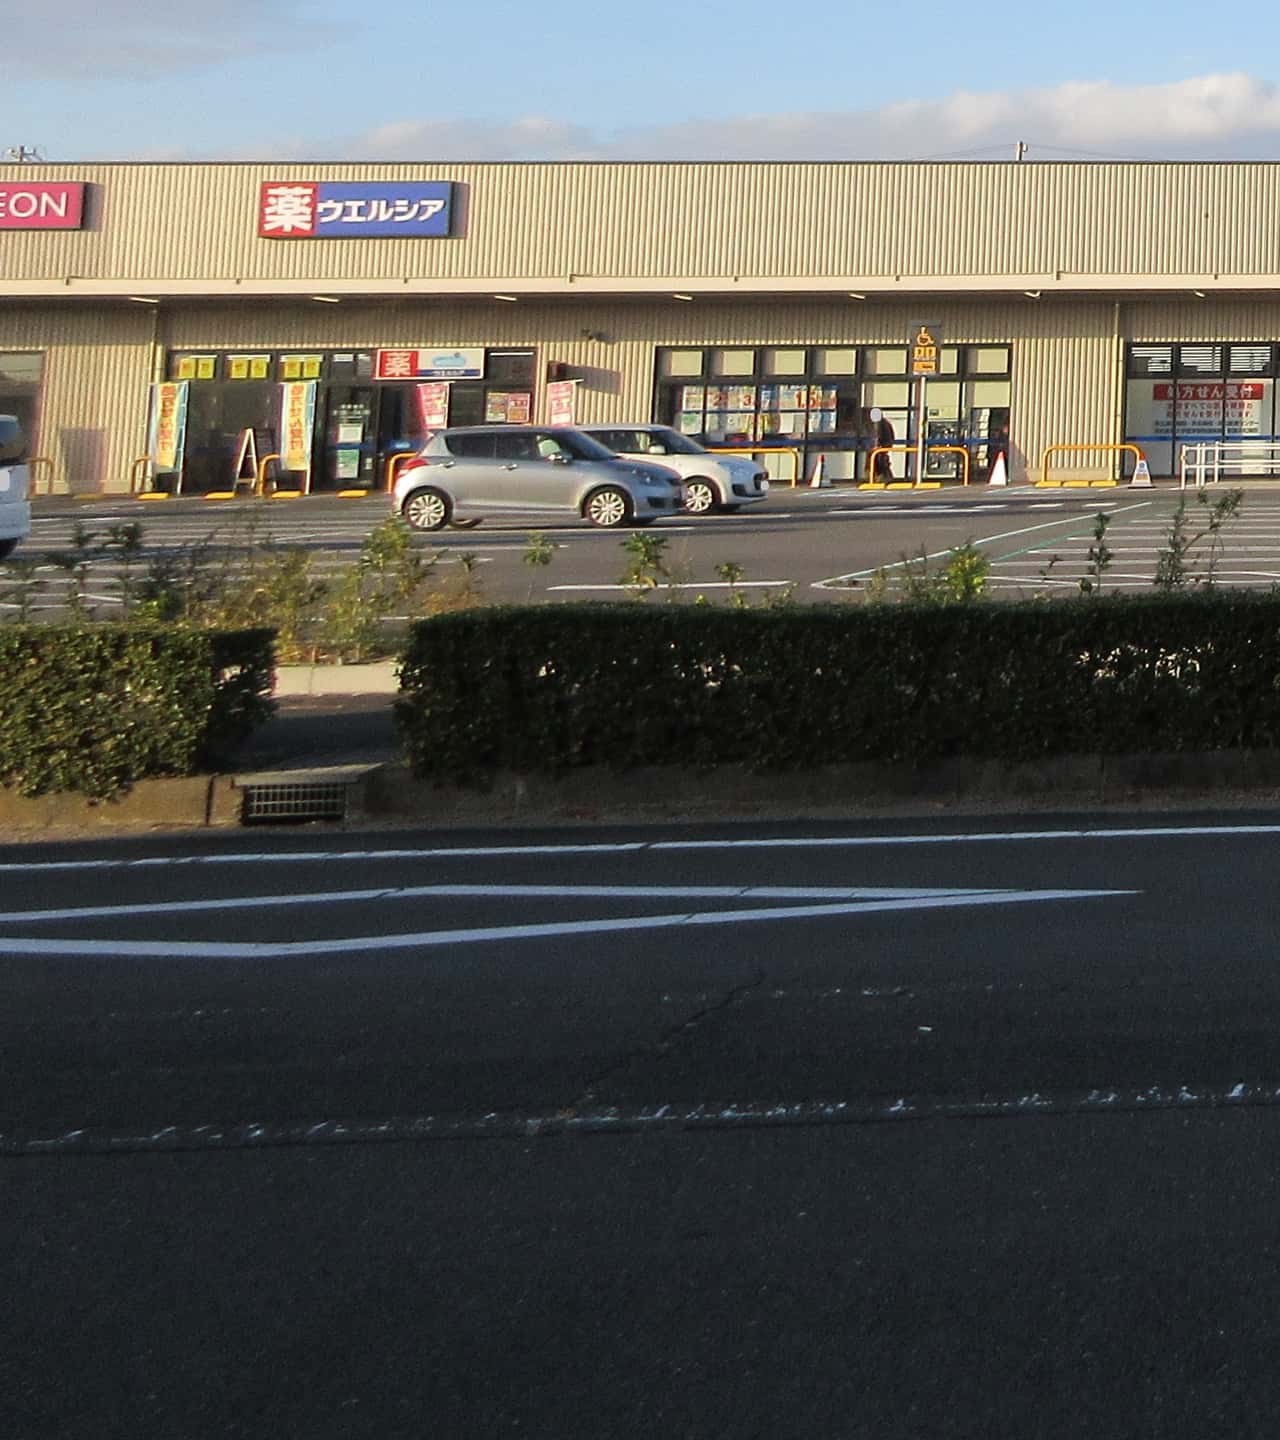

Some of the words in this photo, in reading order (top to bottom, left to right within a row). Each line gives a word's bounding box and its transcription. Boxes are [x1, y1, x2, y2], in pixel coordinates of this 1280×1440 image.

[264, 187, 313, 232] 薬
[317, 199, 445, 222] ウエルシア
[385, 353, 411, 377] 薬
[1167, 385, 1254, 399] 処方せん受付
